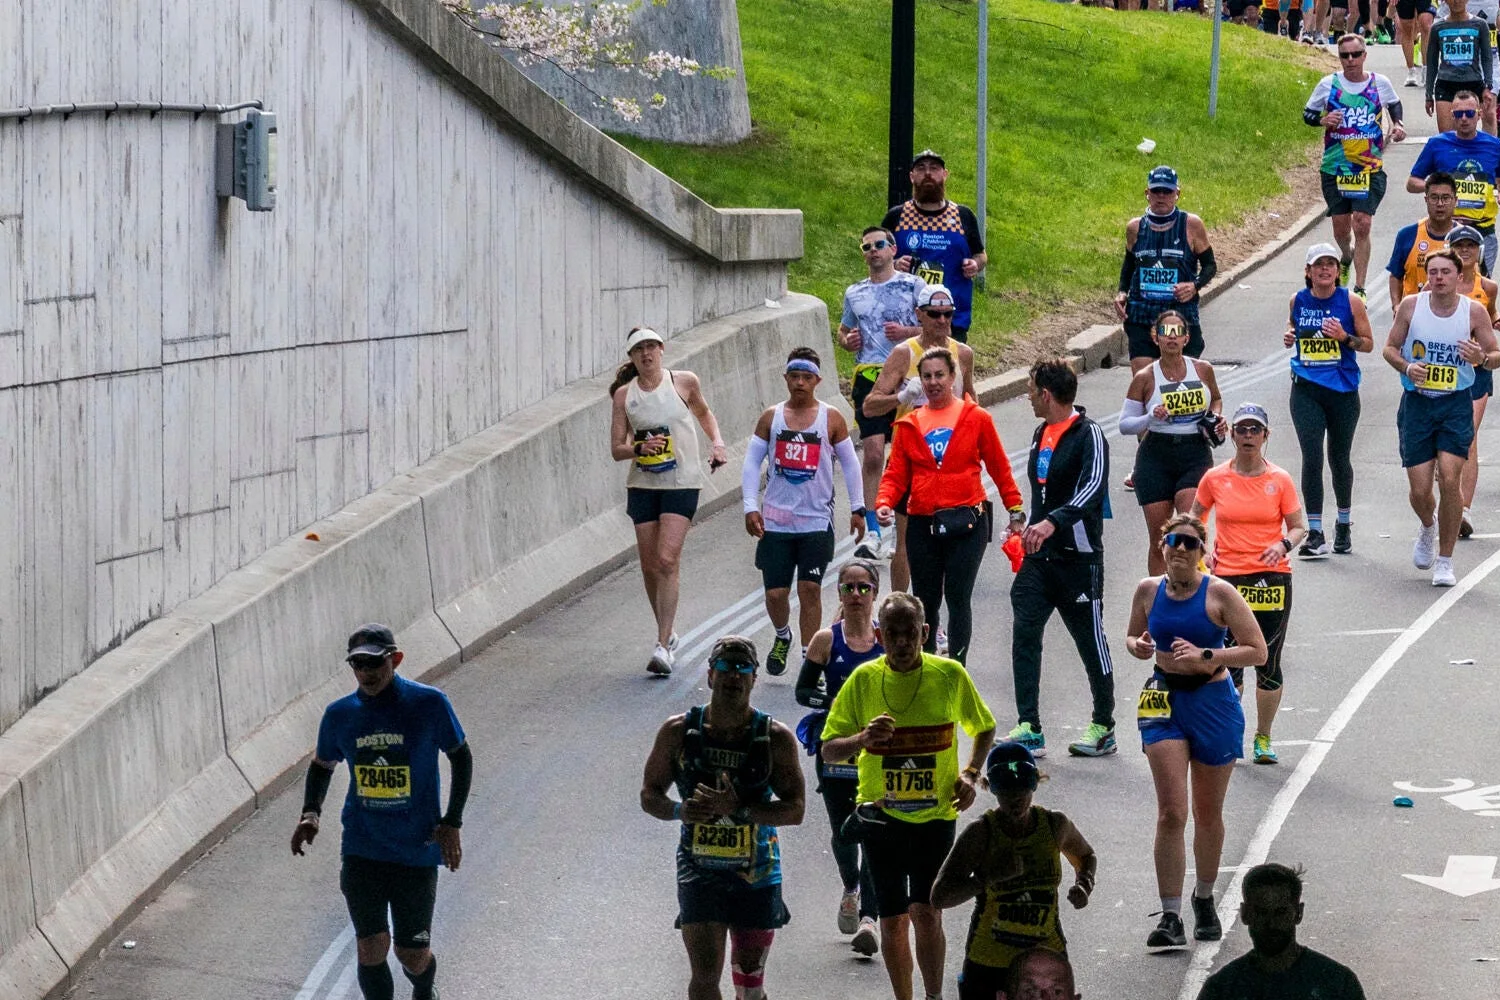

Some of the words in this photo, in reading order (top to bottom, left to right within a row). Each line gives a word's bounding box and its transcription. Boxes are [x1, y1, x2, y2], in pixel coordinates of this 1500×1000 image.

[1142, 269, 1175, 284] 25032
[1300, 306, 1324, 317] Team
[1299, 317, 1322, 327] Tufts
[1302, 339, 1338, 354] 28204
[1165, 390, 1204, 410] 32428
[784, 442, 809, 462] 321
[355, 733, 405, 749] BOSTON
[359, 767, 407, 789] 28465
[885, 771, 934, 792] 31758
[697, 826, 746, 848] 32361
